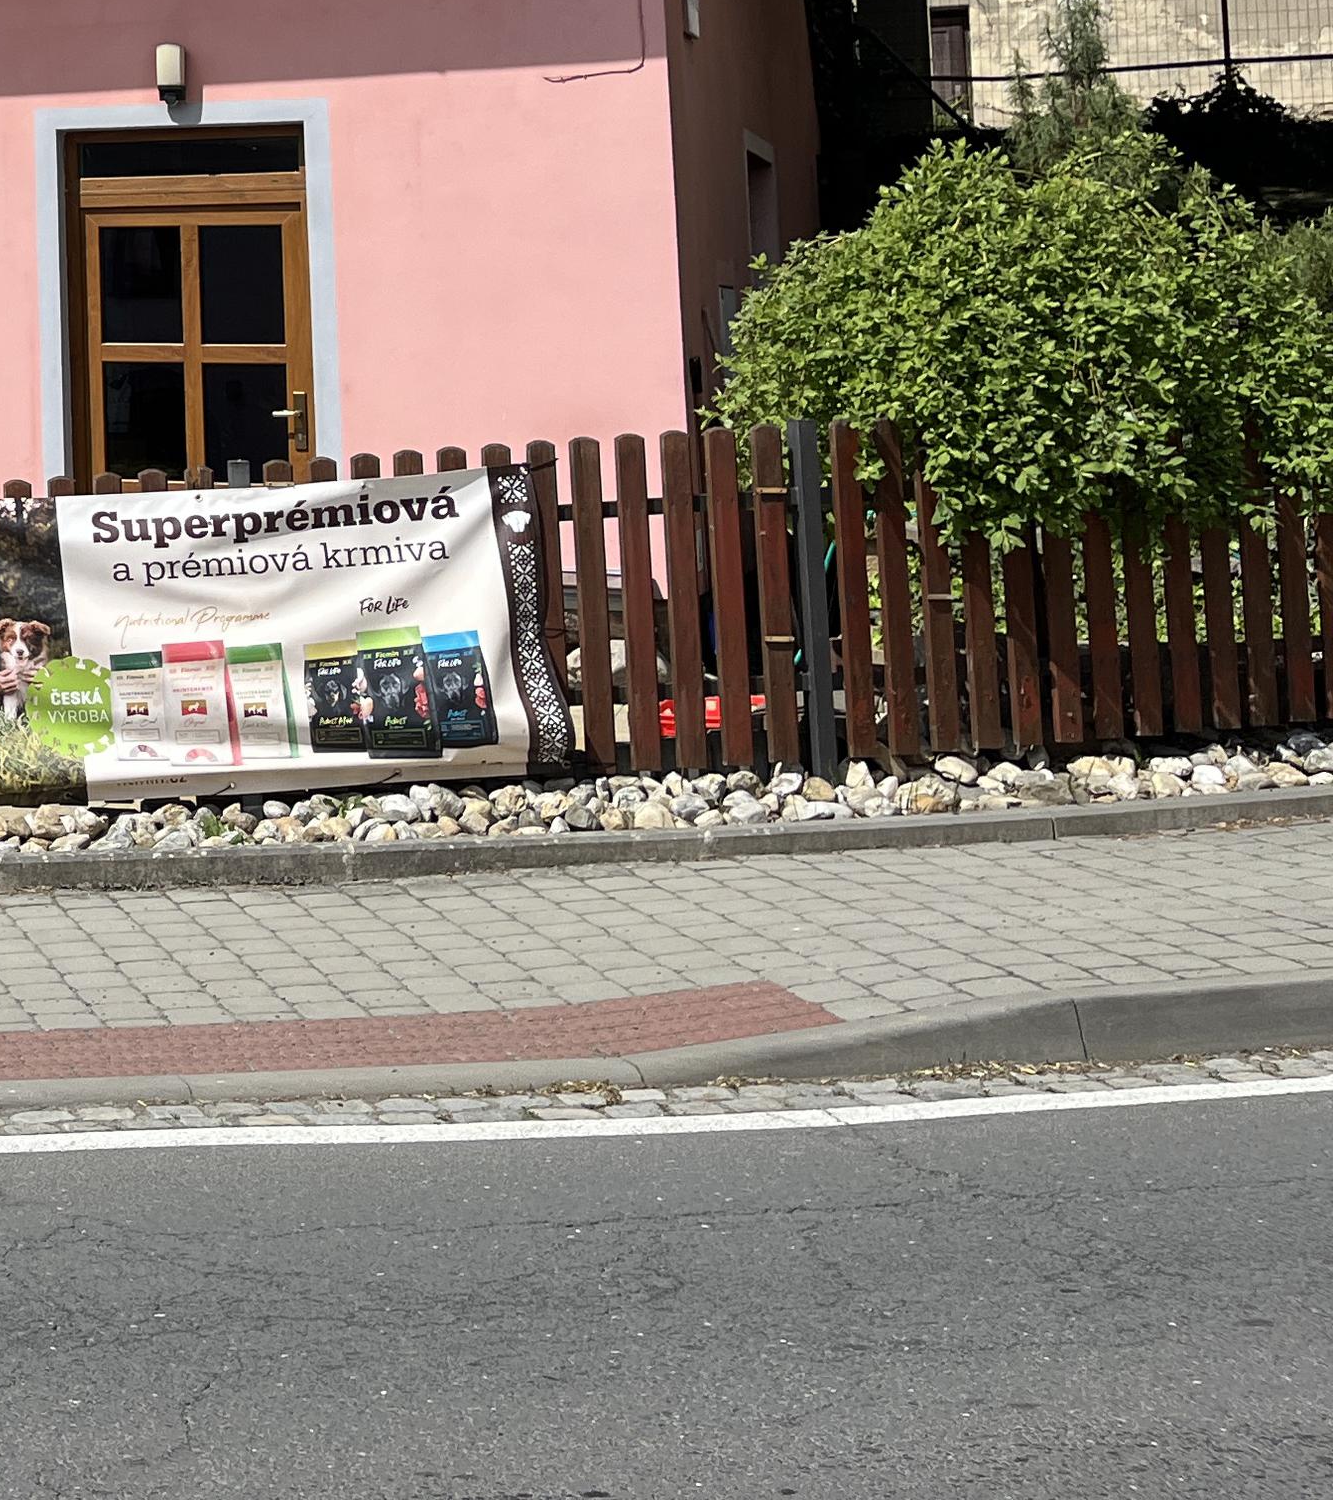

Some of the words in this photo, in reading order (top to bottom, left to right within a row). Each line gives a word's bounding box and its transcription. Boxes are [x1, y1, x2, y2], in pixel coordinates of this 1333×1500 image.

[90, 485, 460, 547] Superprémiová
[112, 562, 134, 582] a
[142, 544, 313, 587] prémiová
[322, 536, 450, 570] krmiva
[51, 686, 103, 706] ČESKÁ
